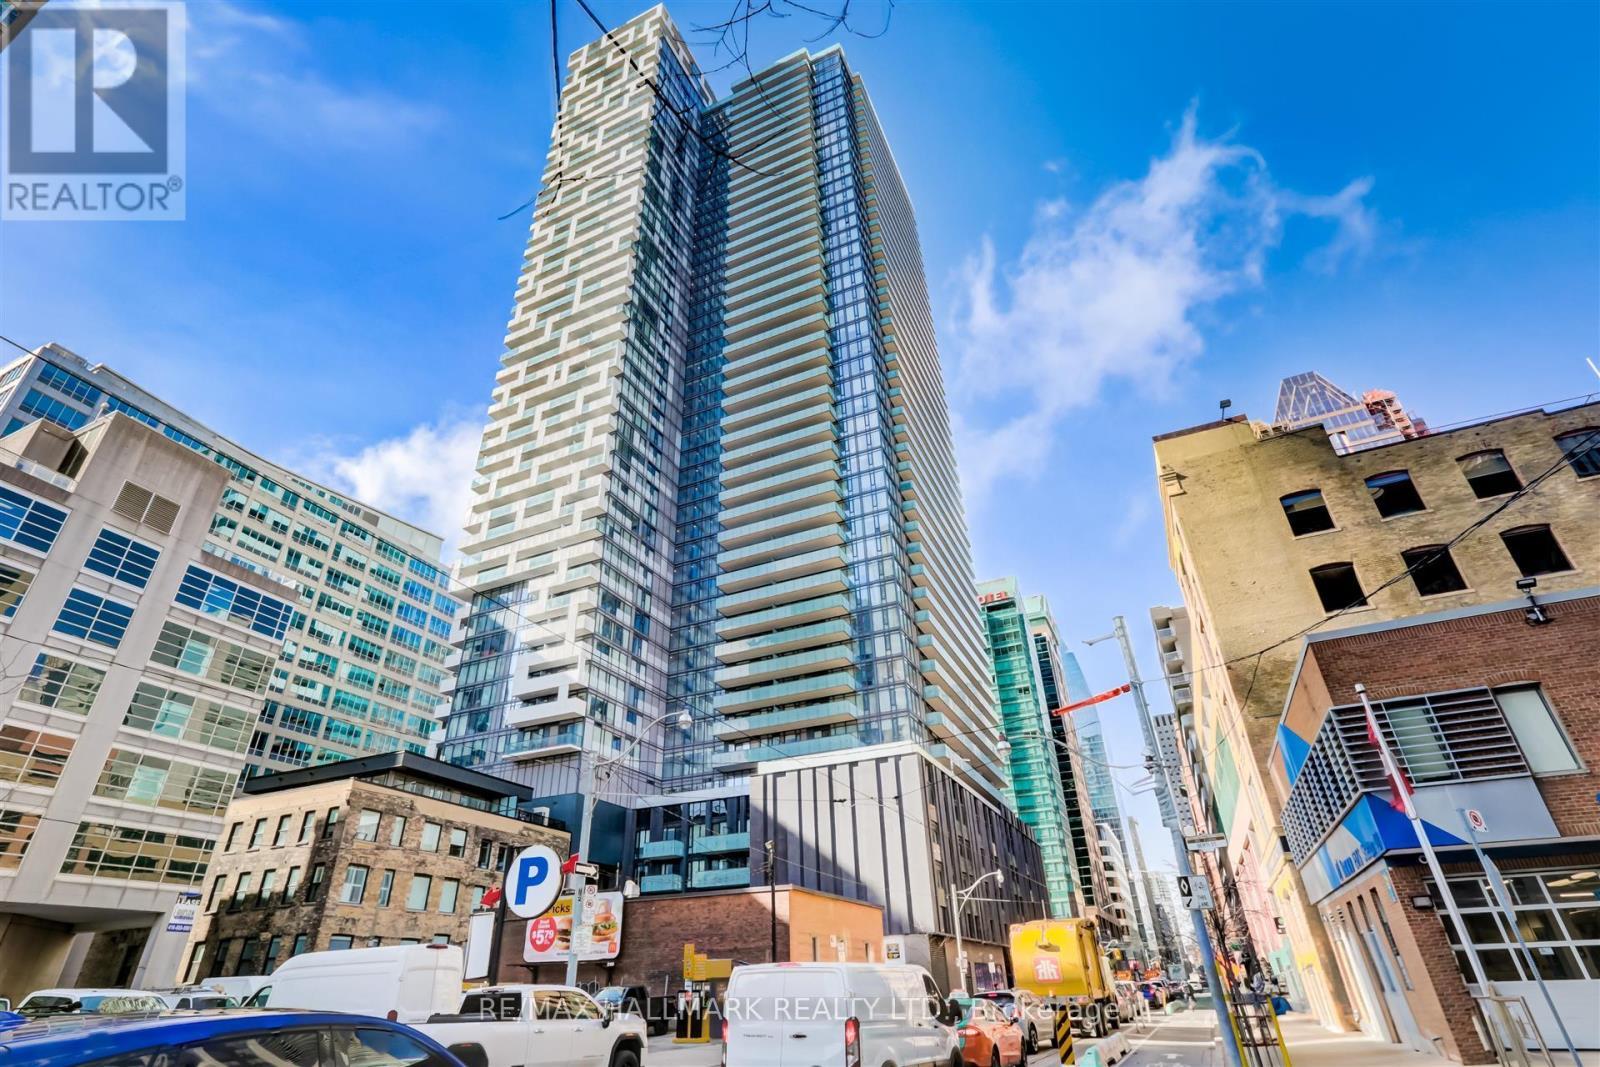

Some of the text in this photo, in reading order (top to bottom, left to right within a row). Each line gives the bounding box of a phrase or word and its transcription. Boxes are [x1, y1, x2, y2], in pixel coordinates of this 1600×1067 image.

[976, 591, 1007, 604] OTEL
[514, 856, 549, 905] P
[552, 903, 571, 914] icks
